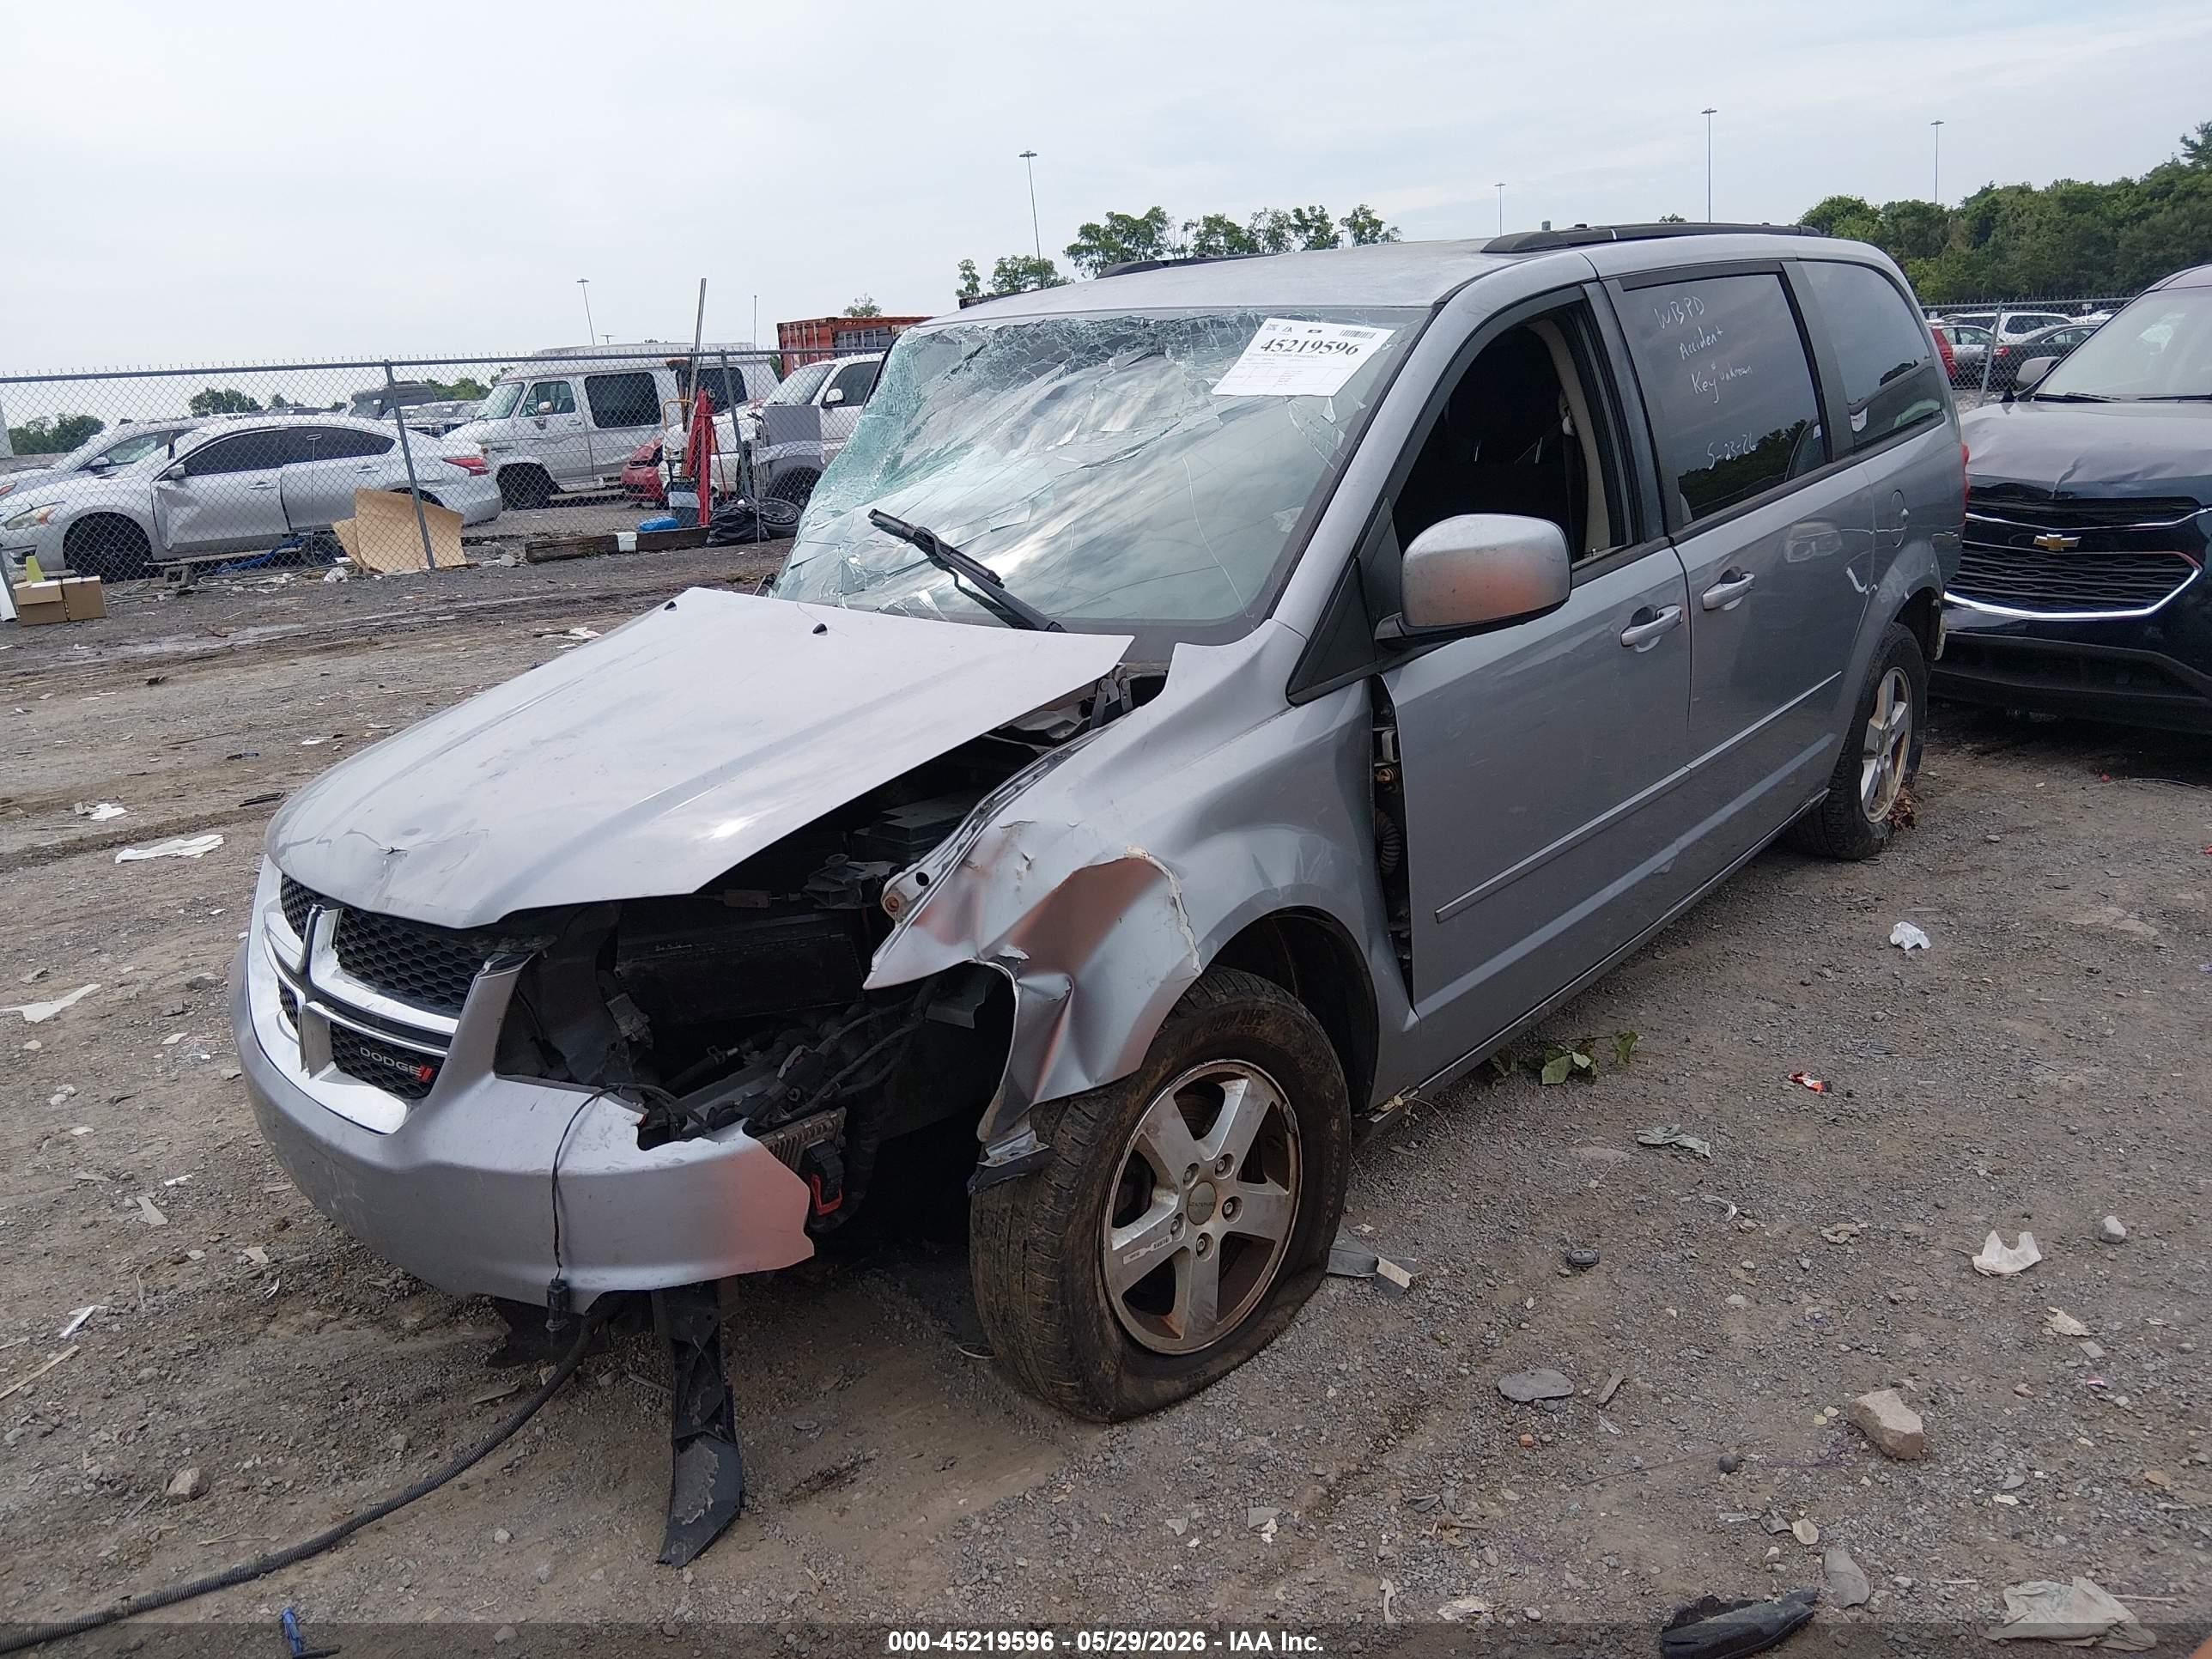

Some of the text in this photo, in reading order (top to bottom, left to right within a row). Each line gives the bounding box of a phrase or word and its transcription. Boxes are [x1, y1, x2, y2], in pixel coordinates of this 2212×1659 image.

[1653, 295, 1705, 330] WBPD
[1260, 337, 1361, 356] 45219596
[1679, 325, 1724, 361] Accident
[1691, 370, 1719, 404] Key
[359, 1046, 422, 1078] DODGE
